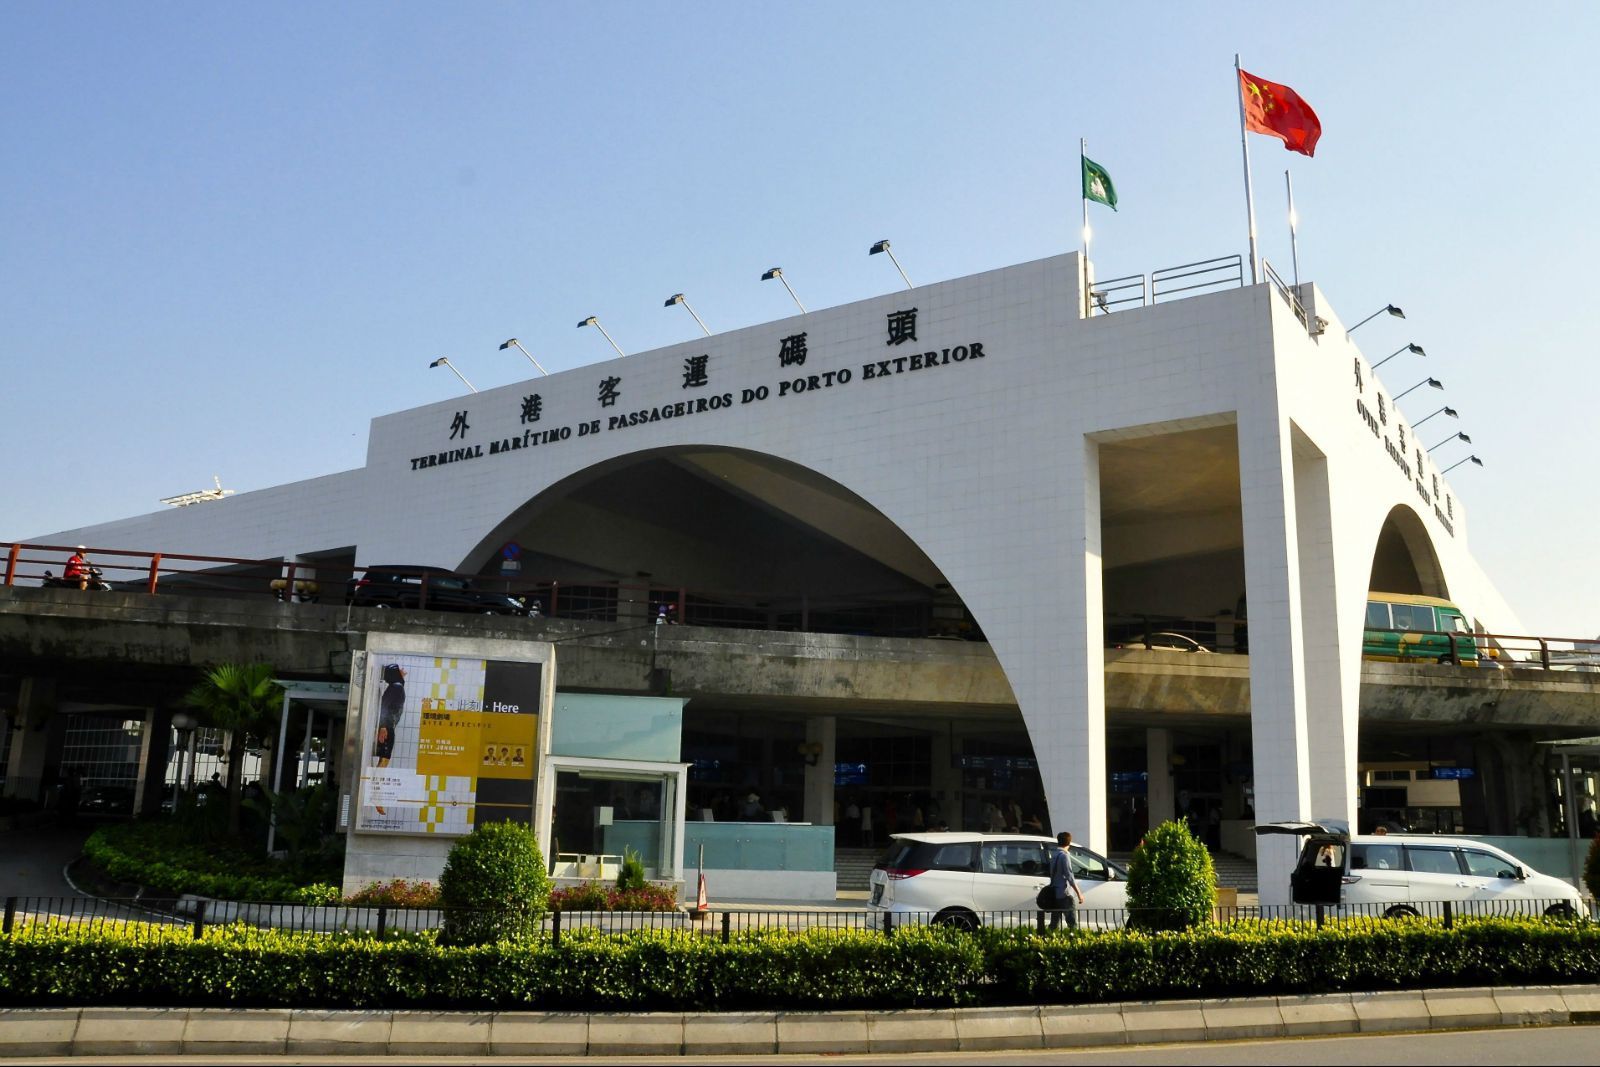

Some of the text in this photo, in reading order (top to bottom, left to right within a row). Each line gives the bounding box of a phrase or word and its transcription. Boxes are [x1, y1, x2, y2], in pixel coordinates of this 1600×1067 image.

[410, 342, 986, 470] TERMINAL MARÍTIMO DE PASSAGEIROS DO PORTO EXTERIOR
[449, 307, 919, 440] 外港客運碼頭
[493, 702, 519, 713] Here
